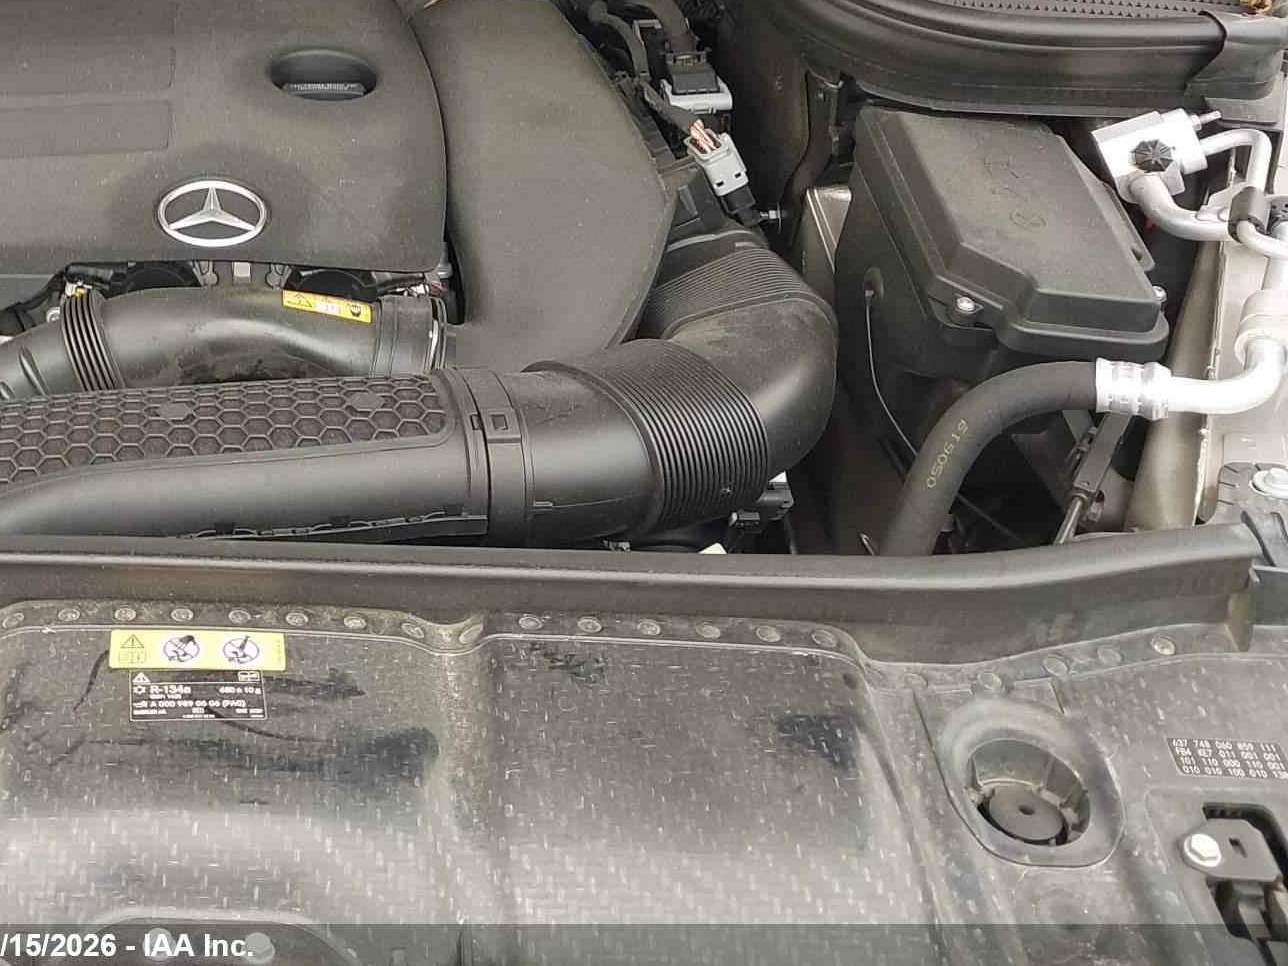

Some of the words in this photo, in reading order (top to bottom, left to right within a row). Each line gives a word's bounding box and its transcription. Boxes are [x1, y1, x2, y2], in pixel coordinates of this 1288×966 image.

[149, 684, 192, 694] R-134a
[244, 686, 254, 694] 10
[158, 700, 176, 708] 000
[222, 699, 246, 708] (PAG)
[1260, 744, 1276, 752] 111
[1219, 750, 1236, 759] 011
[1241, 752, 1258, 760] 001
[1263, 753, 1281, 762] 001
[1180, 756, 1196, 765] 101
[1202, 757, 1219, 766] 110
[1223, 759, 1241, 768] 000
[1246, 760, 1263, 769] 110
[1267, 761, 1286, 770] 001
[1182, 765, 1201, 774] 010
[1204, 767, 1222, 775] 010
[1228, 768, 1245, 777] 100
[1249, 769, 1267, 778] 010
